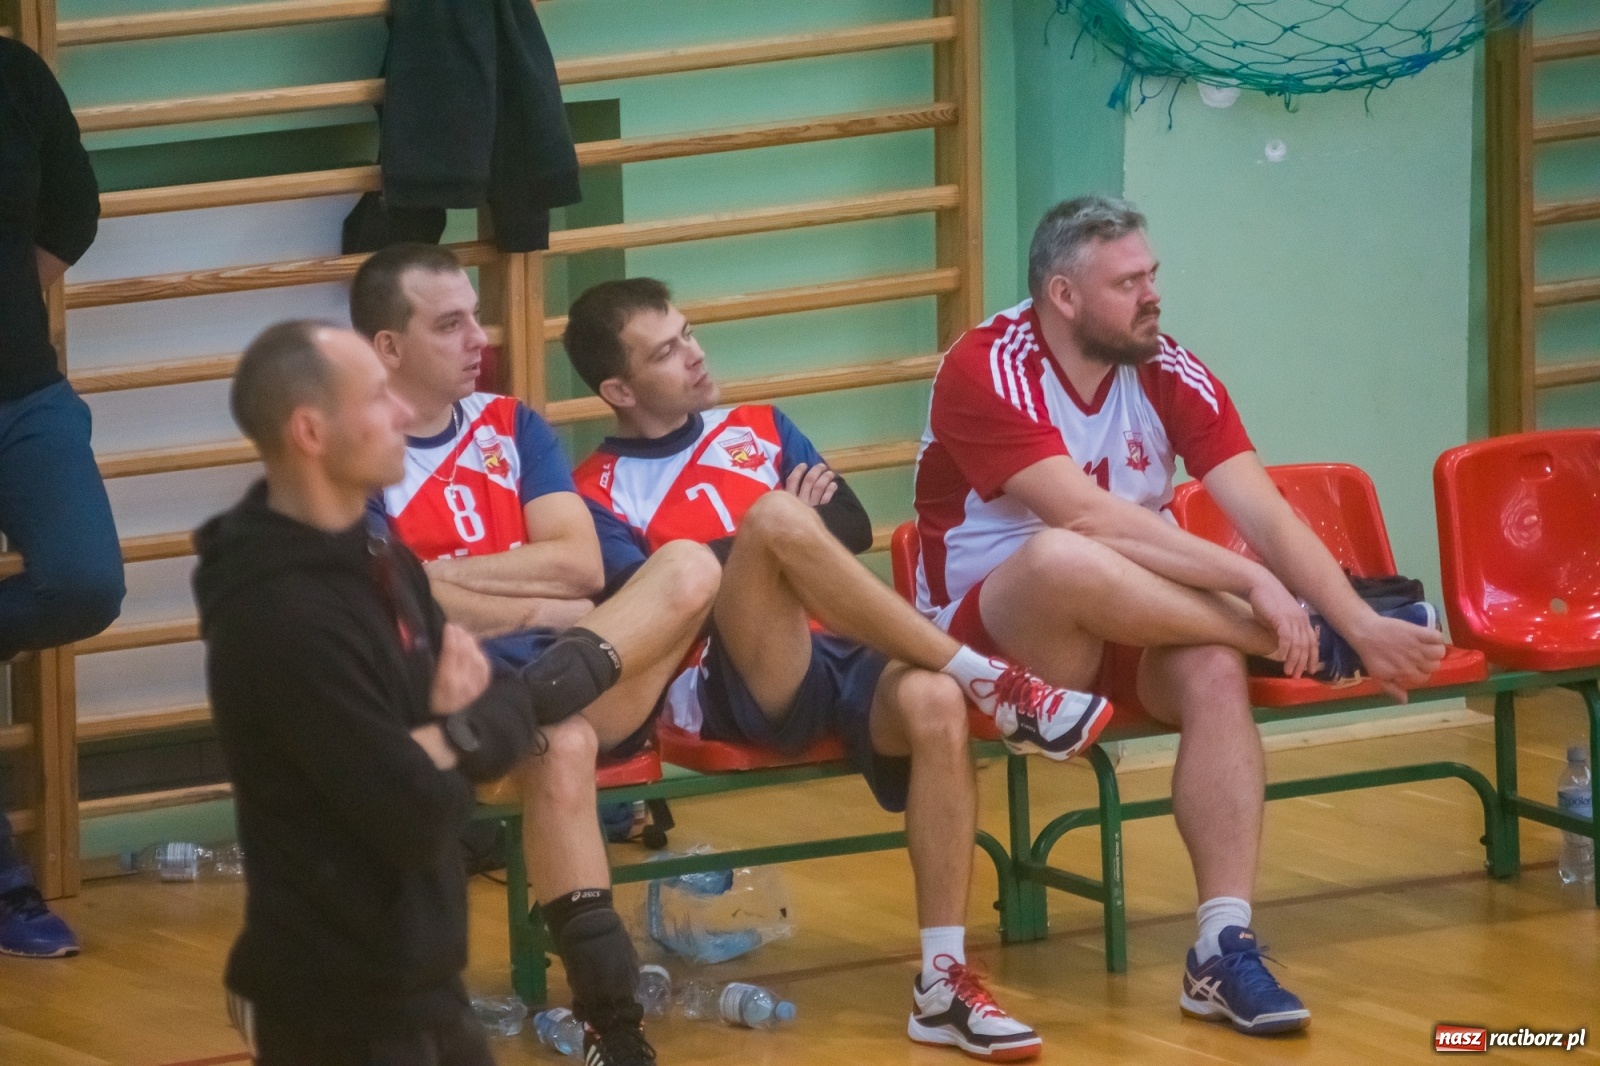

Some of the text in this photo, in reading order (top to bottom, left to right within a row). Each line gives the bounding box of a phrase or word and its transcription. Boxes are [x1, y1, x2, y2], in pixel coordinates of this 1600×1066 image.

[443, 484, 486, 543] 8
[685, 482, 736, 533] 7
[581, 890, 601, 899] asics
